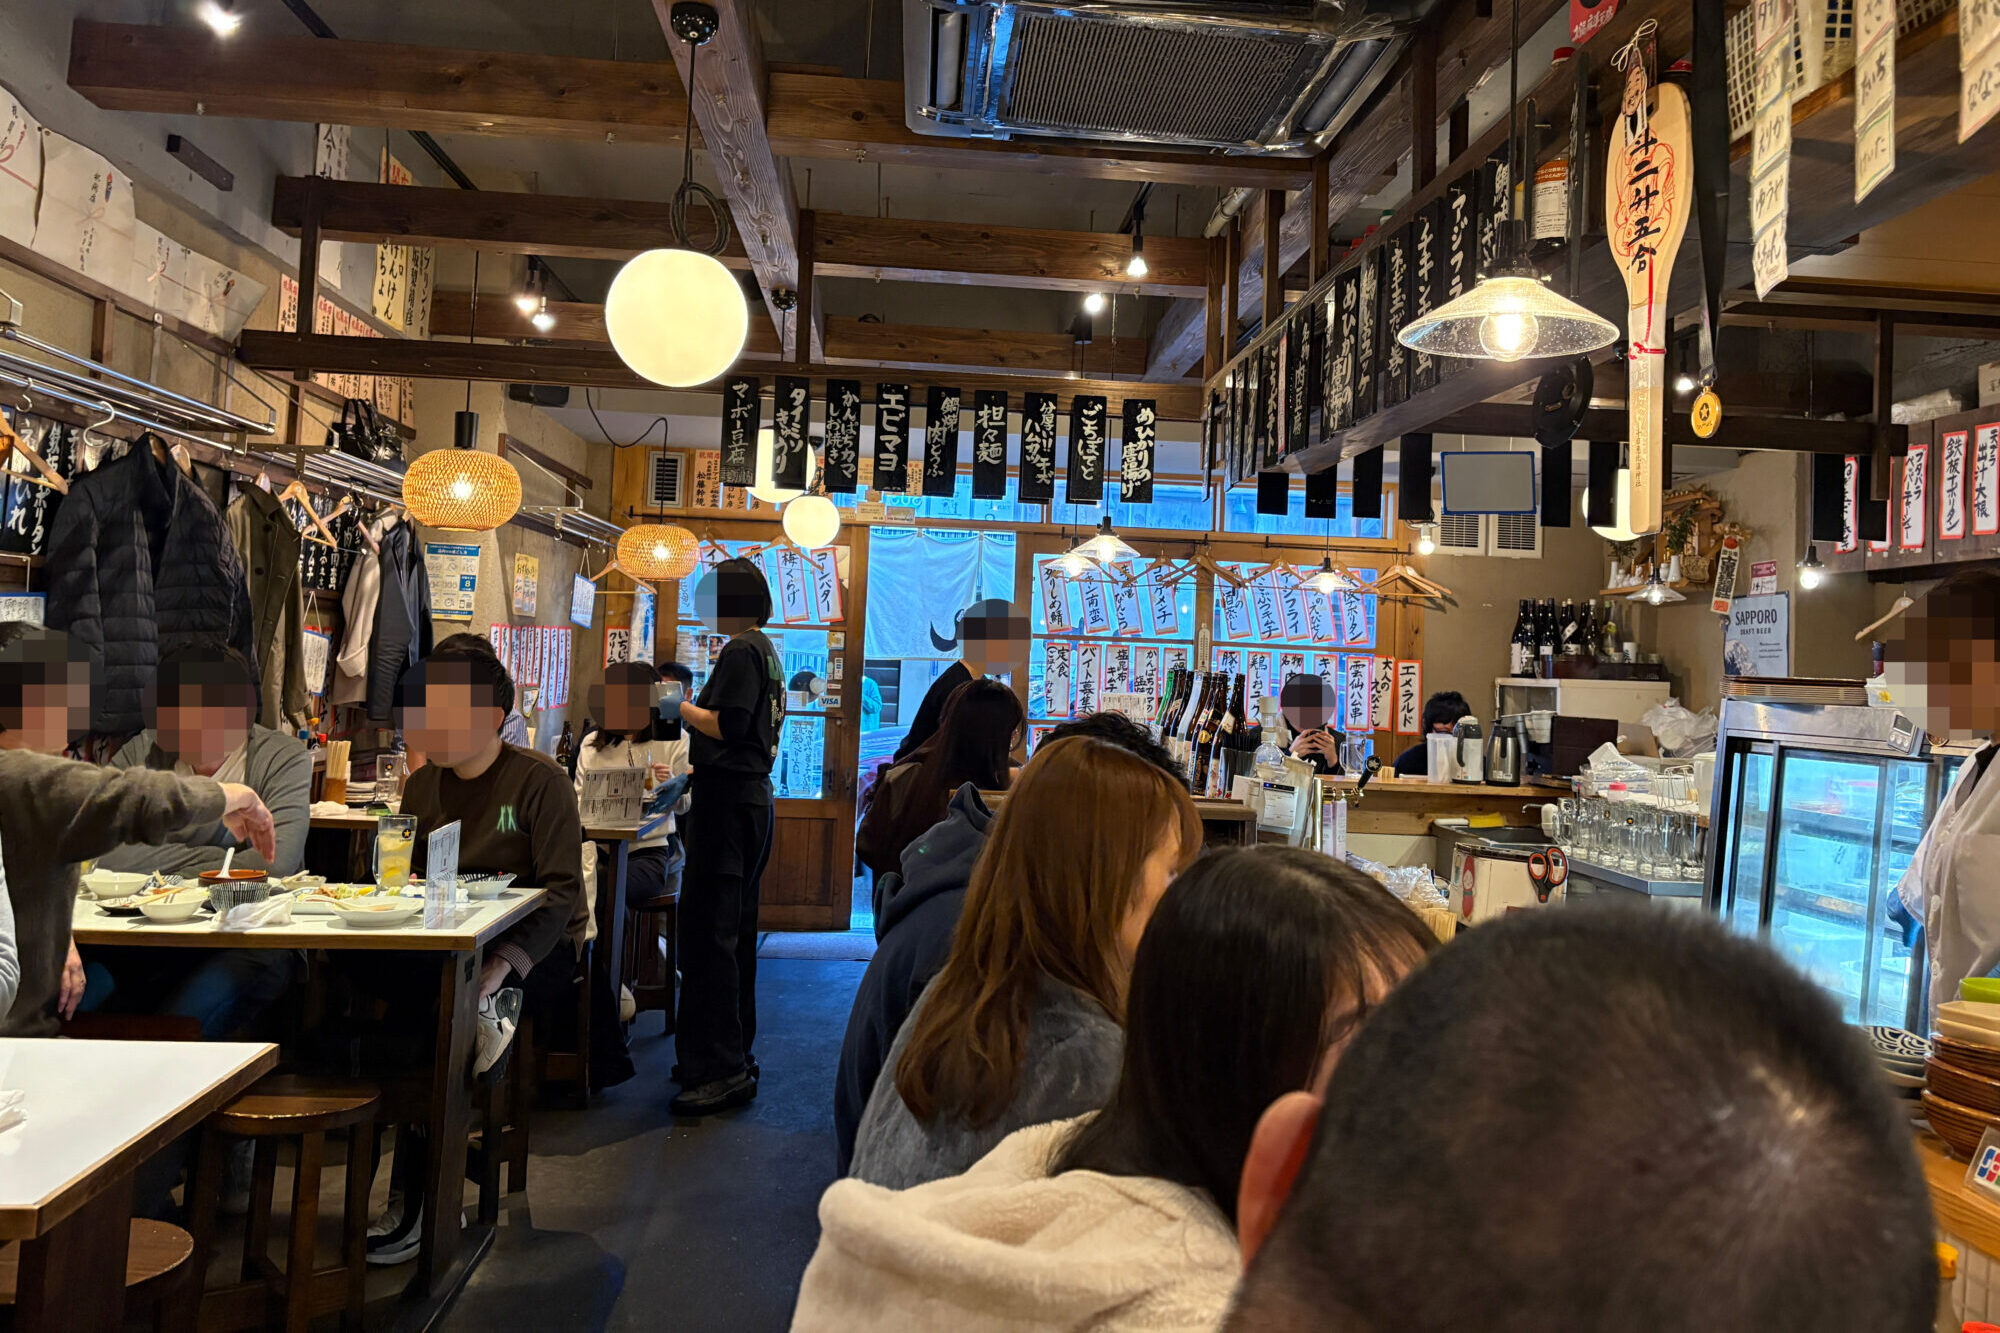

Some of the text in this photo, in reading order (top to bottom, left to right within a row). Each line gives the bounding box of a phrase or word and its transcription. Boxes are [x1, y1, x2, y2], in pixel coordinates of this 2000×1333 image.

[1628, 116, 1660, 275] 斗二升五合
[774, 408, 792, 475] きゅうり
[878, 392, 906, 472] エビマヨ
[1945, 436, 1963, 532] 鉄板ナポリタン
[781, 551, 801, 608] 梅くらげ
[817, 552, 834, 613] コーンバター
[1085, 572, 1105, 625] キン南蛮
[1735, 608, 1777, 626] SAPPORO
[1056, 646, 1070, 678] 定食
[1079, 647, 1097, 713] バイト募集
[1105, 666, 1118, 693] キムチ
[1380, 656, 1393, 692] 大人の
[820, 697, 839, 705] VISA
[1399, 665, 1417, 728] エメラルド
